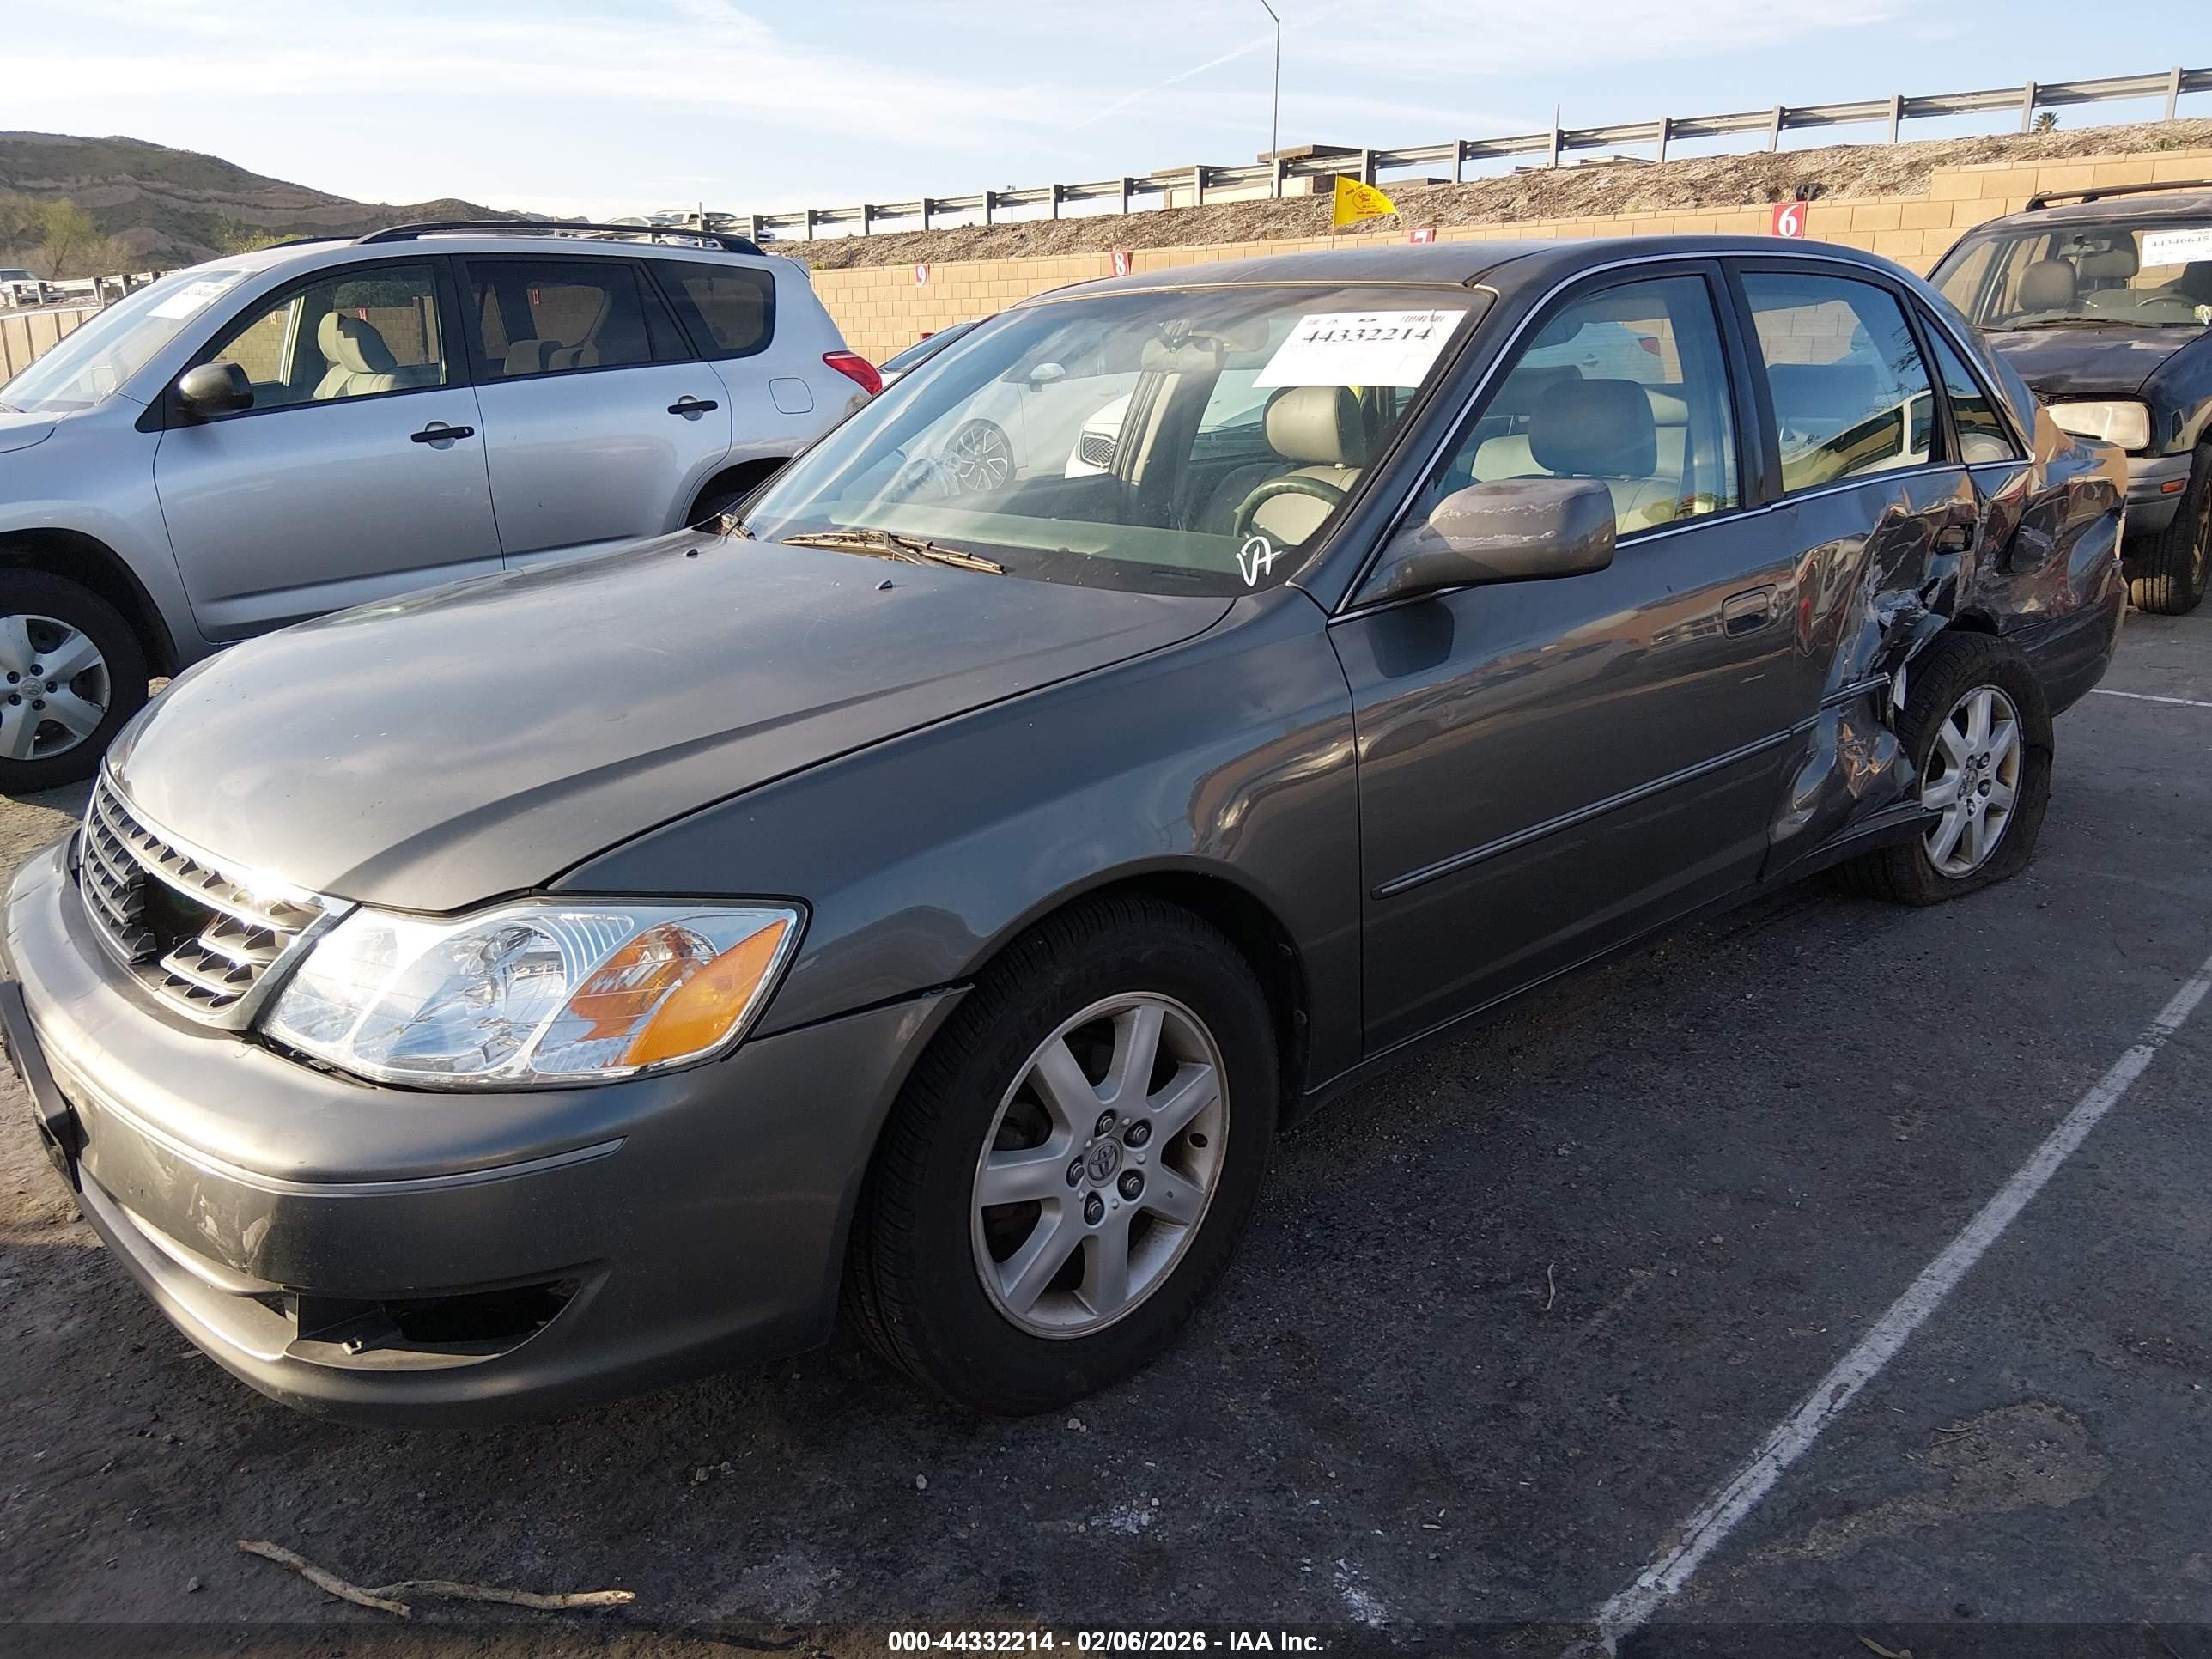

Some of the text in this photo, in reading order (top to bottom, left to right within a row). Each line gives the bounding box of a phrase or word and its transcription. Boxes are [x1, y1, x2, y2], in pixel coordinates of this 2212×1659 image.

[1778, 204, 1797, 237] 6
[916, 264, 927, 286] 9
[1114, 252, 1127, 276] 8
[1303, 327, 1431, 343] 44332214
